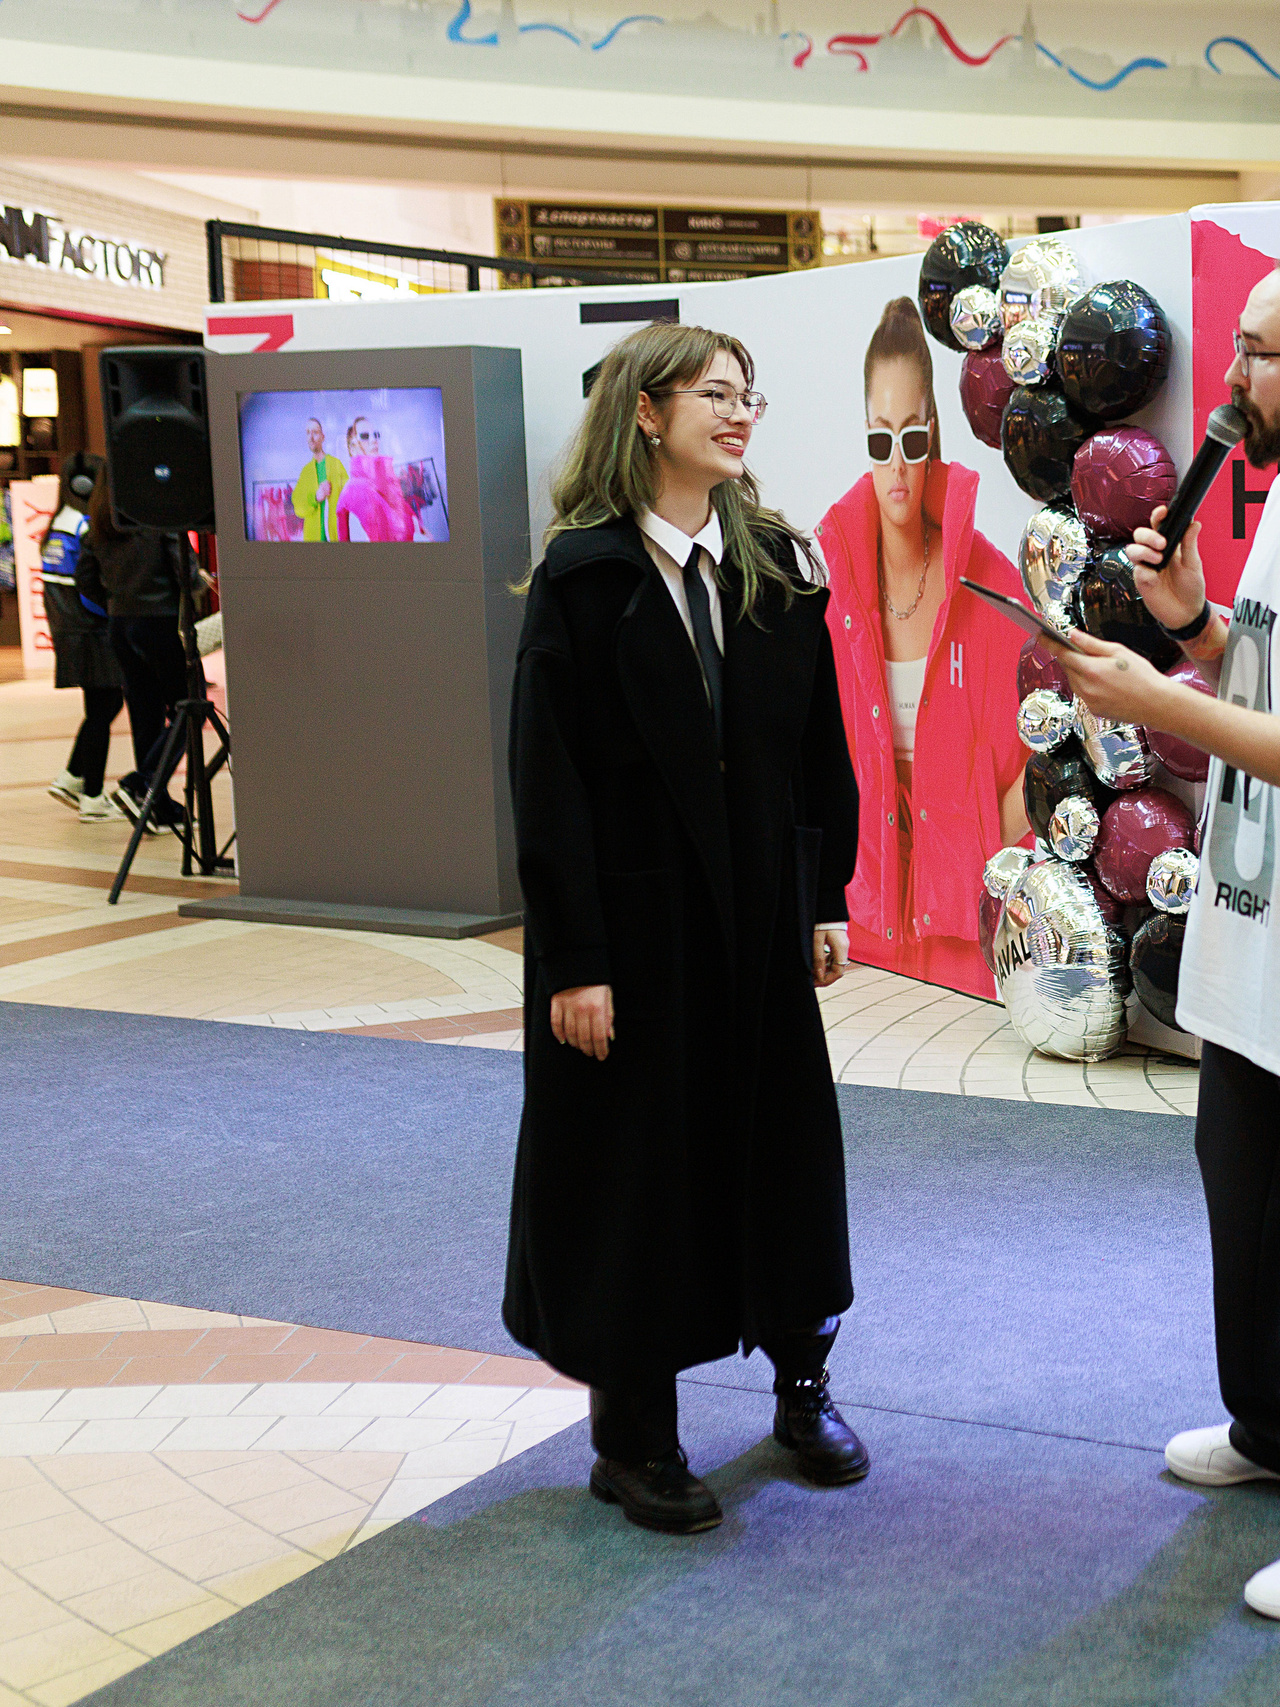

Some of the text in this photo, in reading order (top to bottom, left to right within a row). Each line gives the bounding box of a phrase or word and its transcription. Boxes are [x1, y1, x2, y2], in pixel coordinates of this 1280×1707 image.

[1232, 596, 1270, 629] UMA
[950, 641, 963, 689] H
[997, 931, 1032, 987] AVAL
